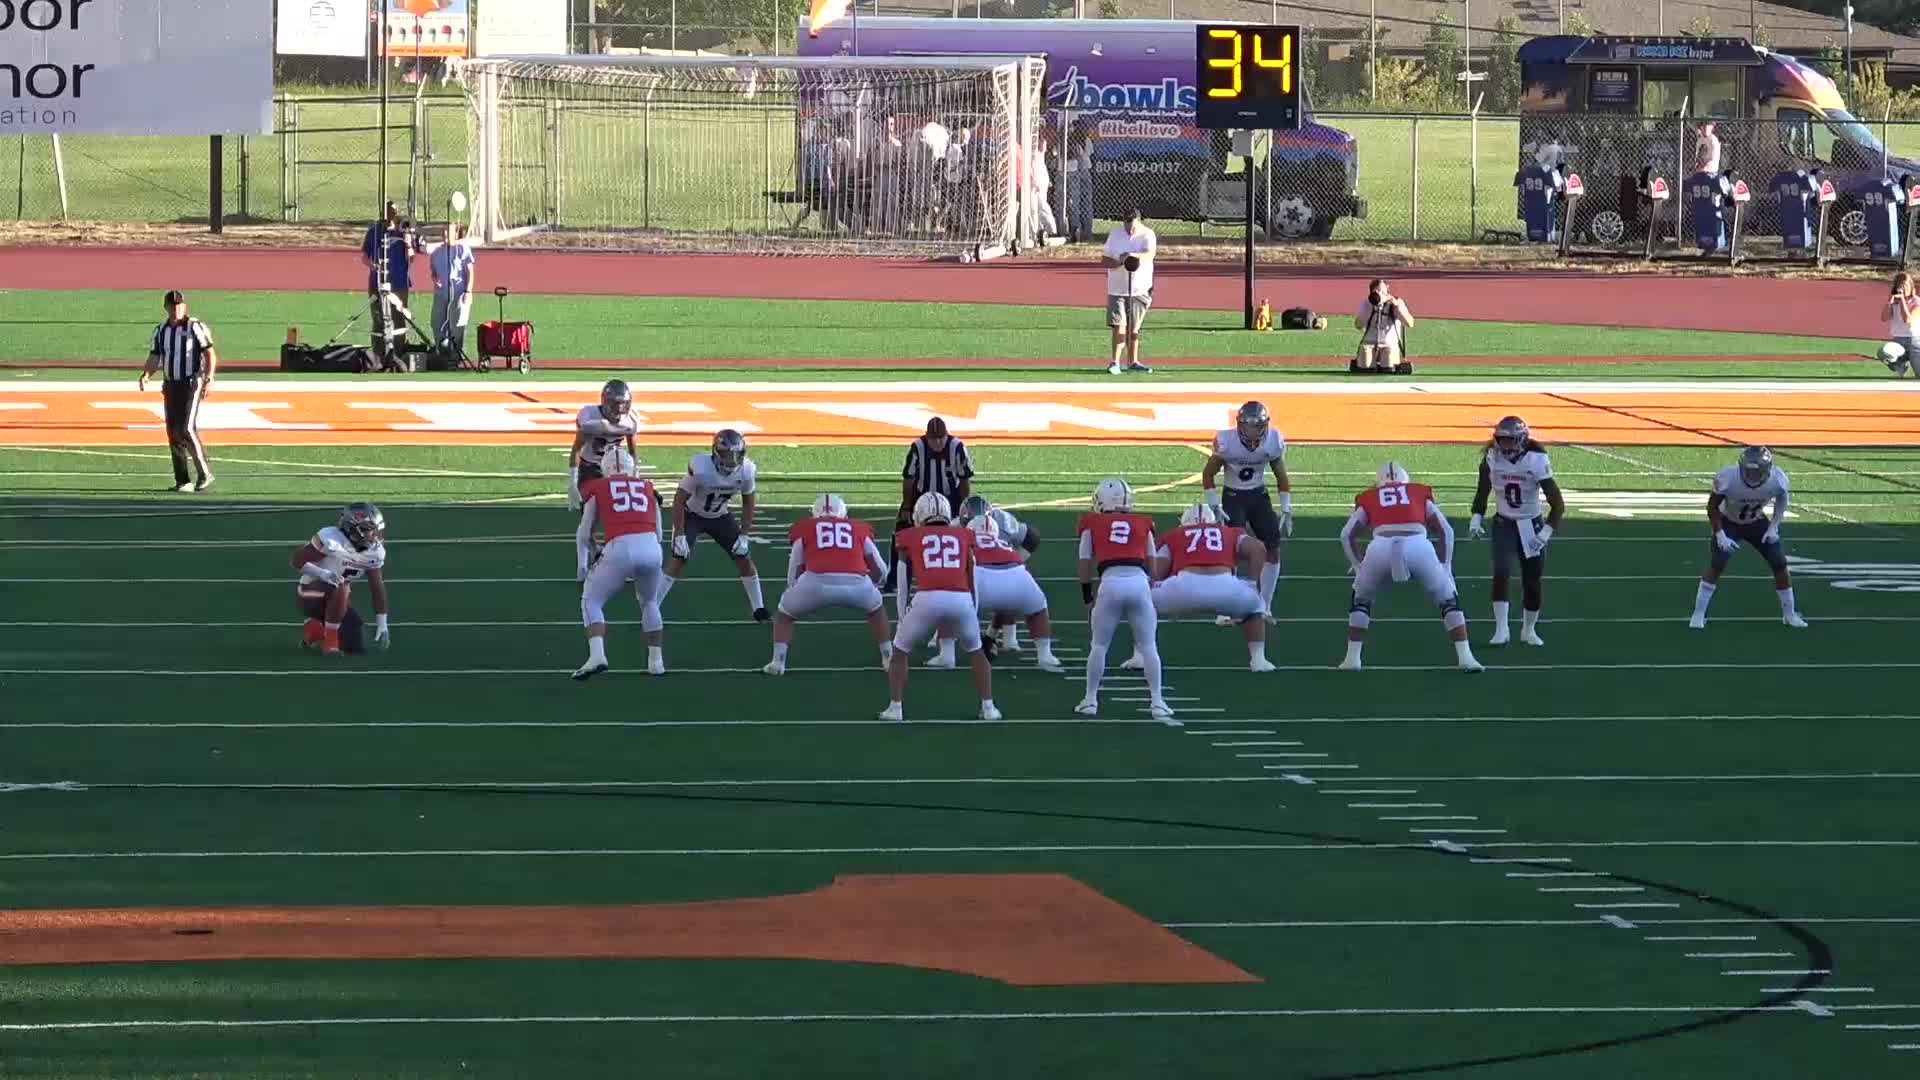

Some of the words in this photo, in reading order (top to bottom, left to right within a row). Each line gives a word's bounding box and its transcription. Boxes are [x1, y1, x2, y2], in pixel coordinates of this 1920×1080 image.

[1208, 29, 1292, 97] 34
[1074, 76, 1197, 113] bowls
[608, 481, 649, 513] 55
[703, 492, 732, 513] 17
[1378, 485, 1411, 508] 61
[1504, 482, 1522, 509] 0
[815, 521, 853, 549] 66
[1108, 520, 1132, 545] 2
[1184, 527, 1223, 553] 78
[921, 534, 961, 569] 22
